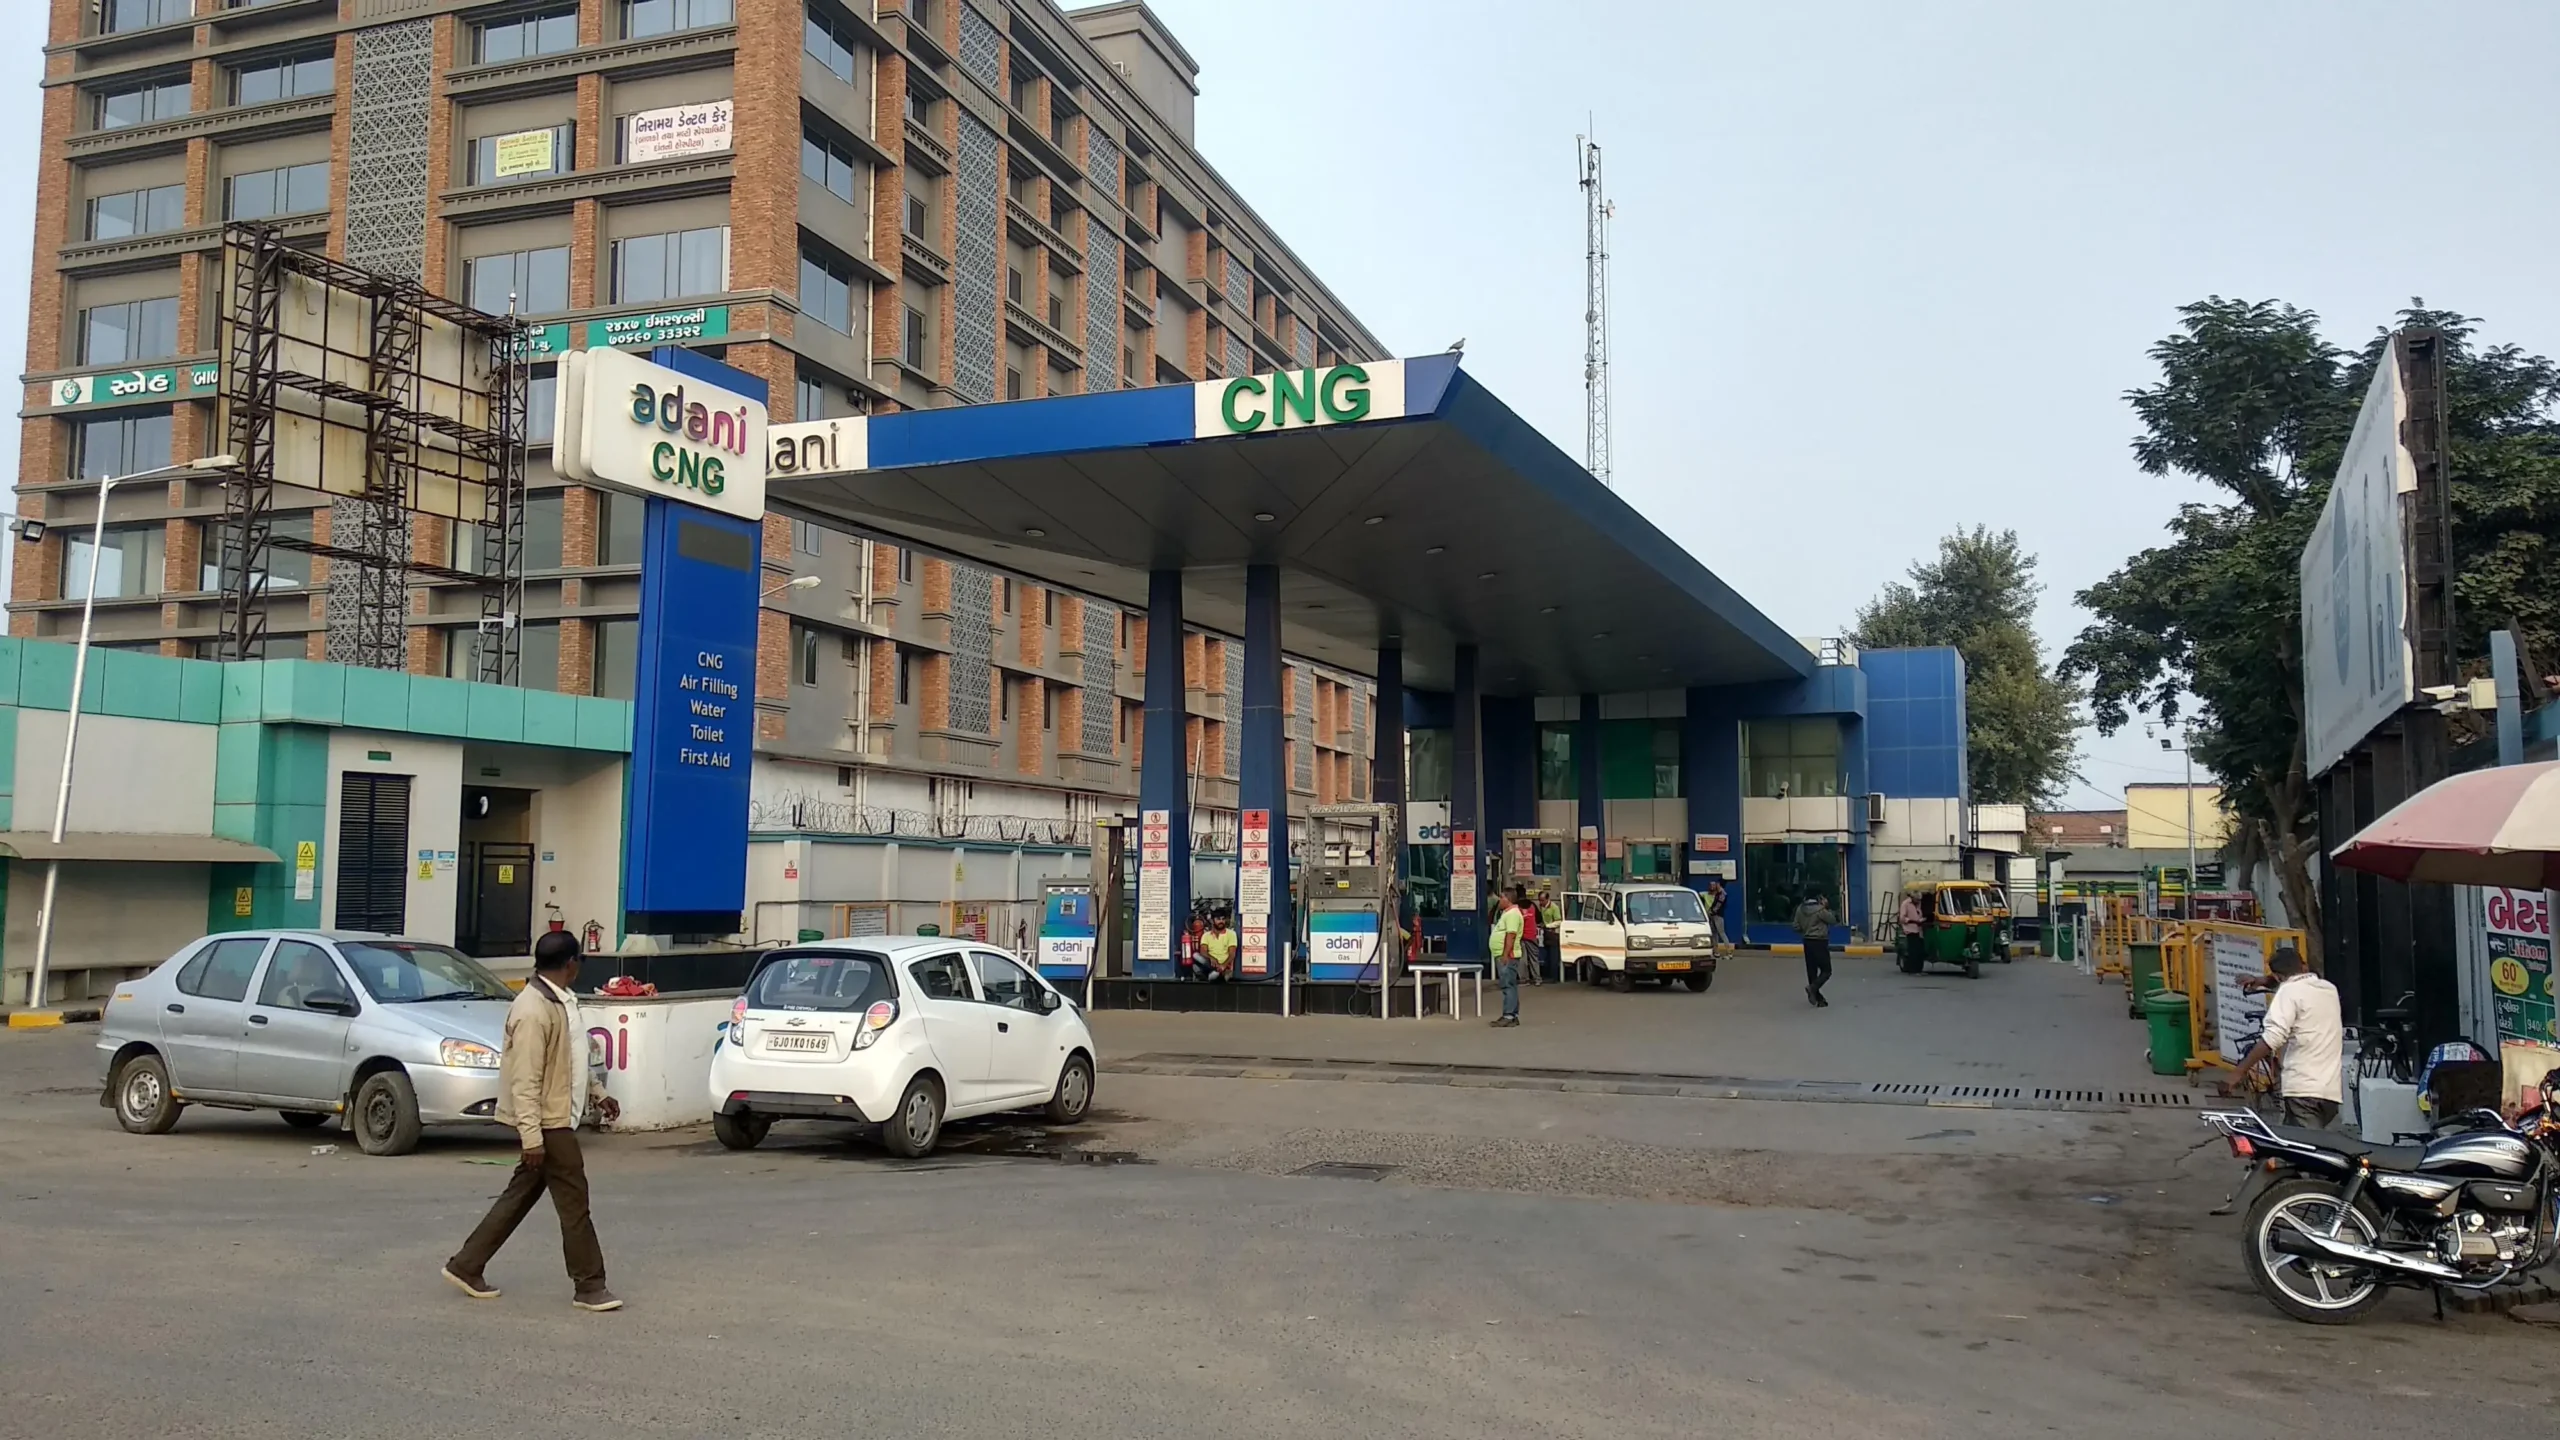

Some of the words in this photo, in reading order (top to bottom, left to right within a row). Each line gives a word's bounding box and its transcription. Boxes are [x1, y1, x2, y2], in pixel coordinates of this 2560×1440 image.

[635, 117, 673, 133] નિરામય
[678, 111, 706, 127] ડેન્ટલ
[712, 106, 727, 123] કેર
[645, 307, 705, 328] ઈમરજન્સી
[657, 326, 701, 341] ૩૩૩૨૨
[110, 371, 169, 396] સ્નેહ
[1221, 364, 1371, 433] CNG
[629, 382, 747, 455] adani
[766, 421, 842, 472] ani
[650, 441, 725, 496] CNG
[698, 651, 723, 669] CNG
[680, 673, 698, 690] Air
[701, 677, 738, 700] Filling
[690, 699, 726, 718] Water
[690, 724, 724, 743] Toilet
[680, 748, 708, 765] First
[710, 751, 730, 768] Aid
[1052, 940, 1083, 952] adani
[1325, 935, 1362, 950] adani
